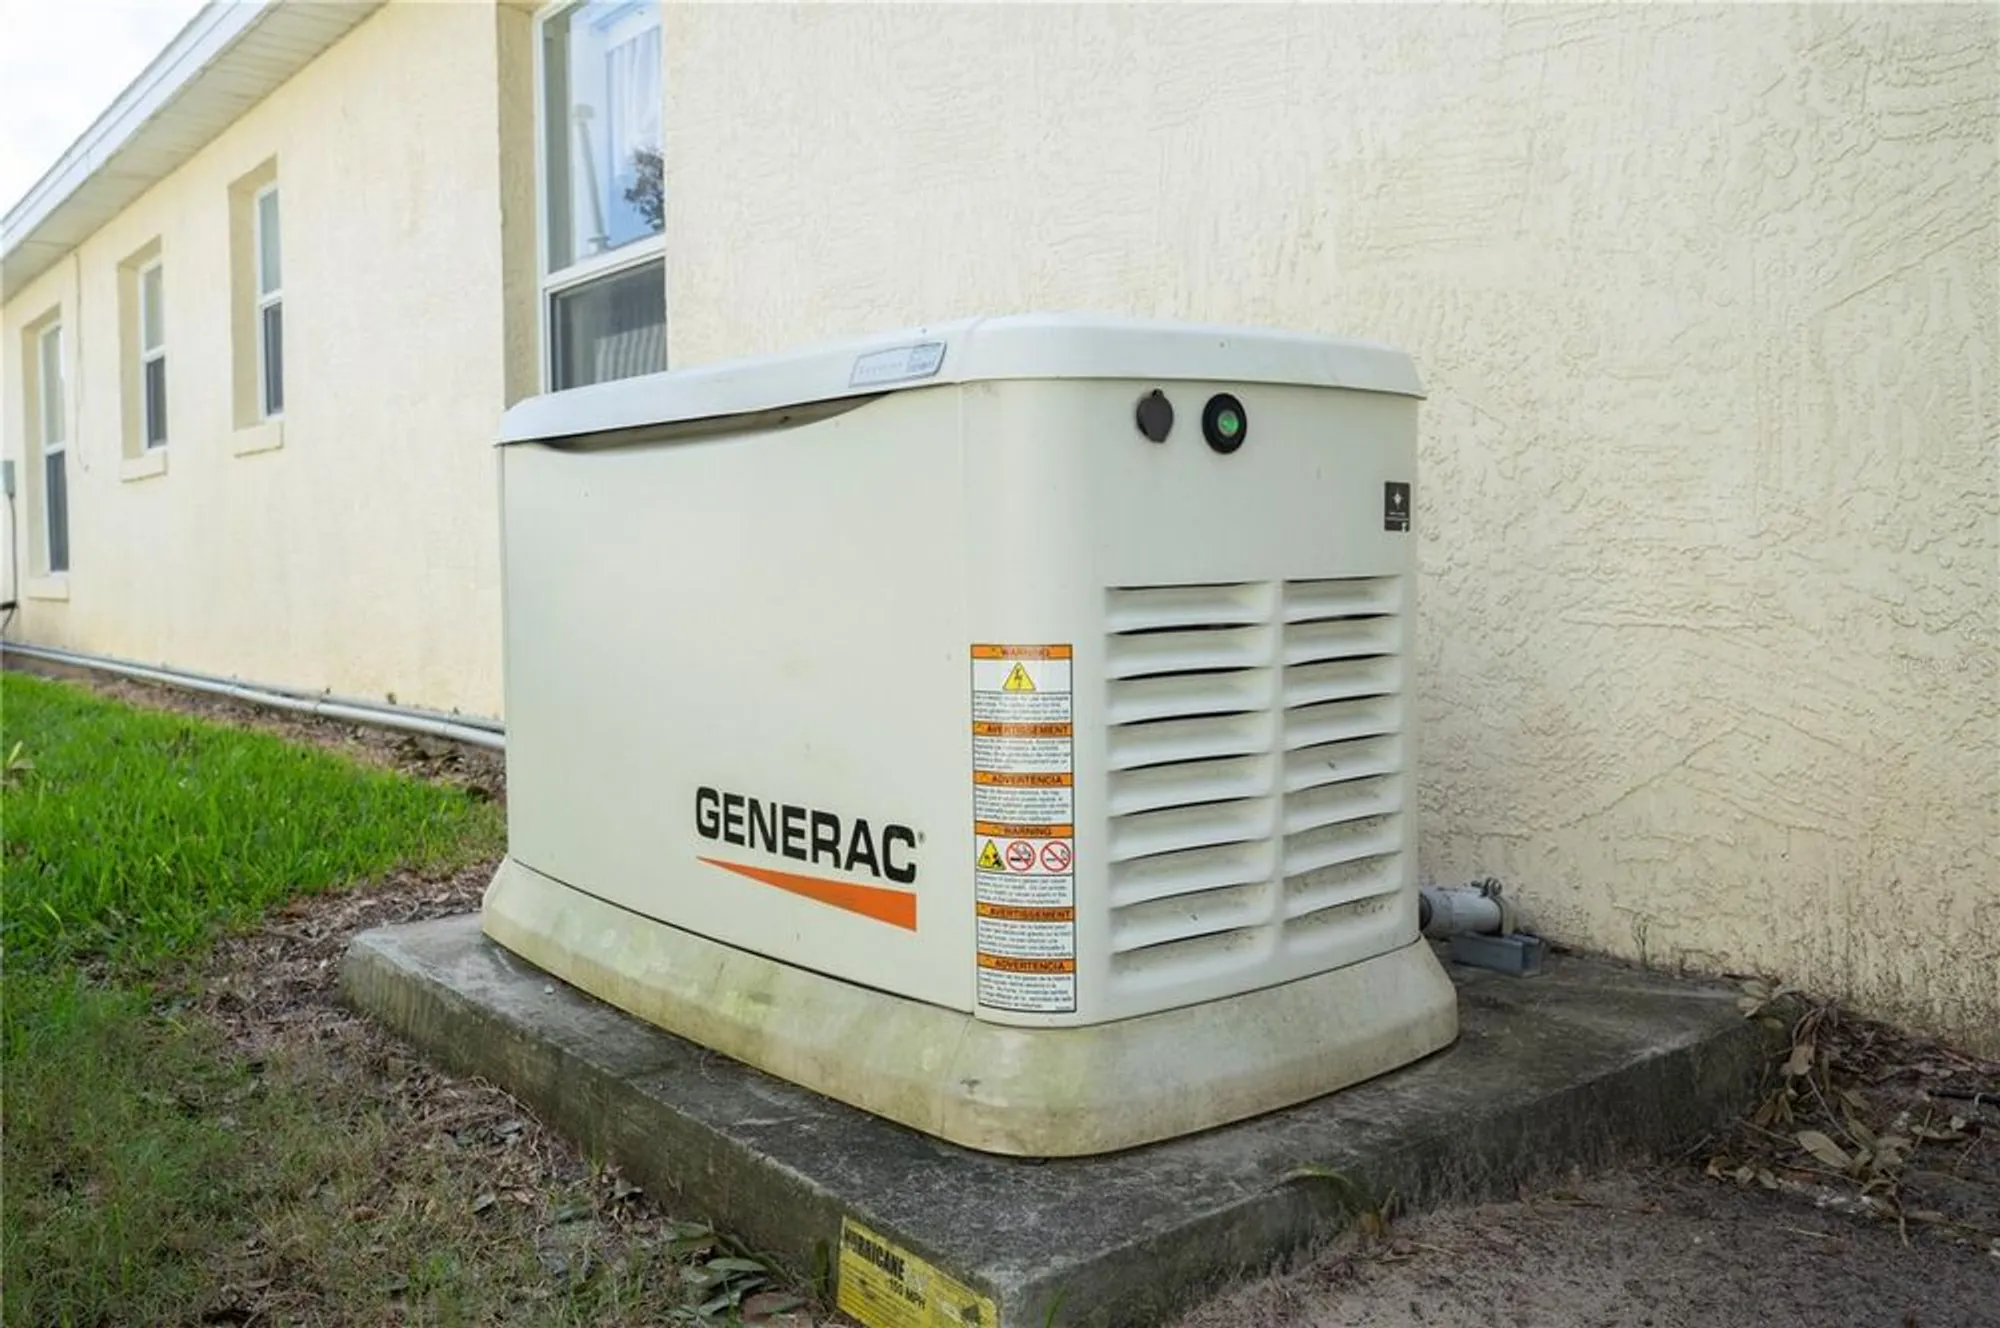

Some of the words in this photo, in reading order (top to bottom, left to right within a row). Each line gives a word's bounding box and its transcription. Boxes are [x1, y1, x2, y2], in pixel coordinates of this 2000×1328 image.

[1001, 647, 1050, 657] WARNING
[987, 725, 1068, 736] AVERTISSEMENT
[992, 775, 1063, 786] ADVERTENCIA
[696, 786, 917, 884] GENERAC
[1004, 827, 1052, 836] WARNING
[990, 908, 1071, 919] AVERTISSEMENT
[995, 960, 1065, 971] ADVERTENCIA
[845, 1229, 905, 1281] HURRICANE
